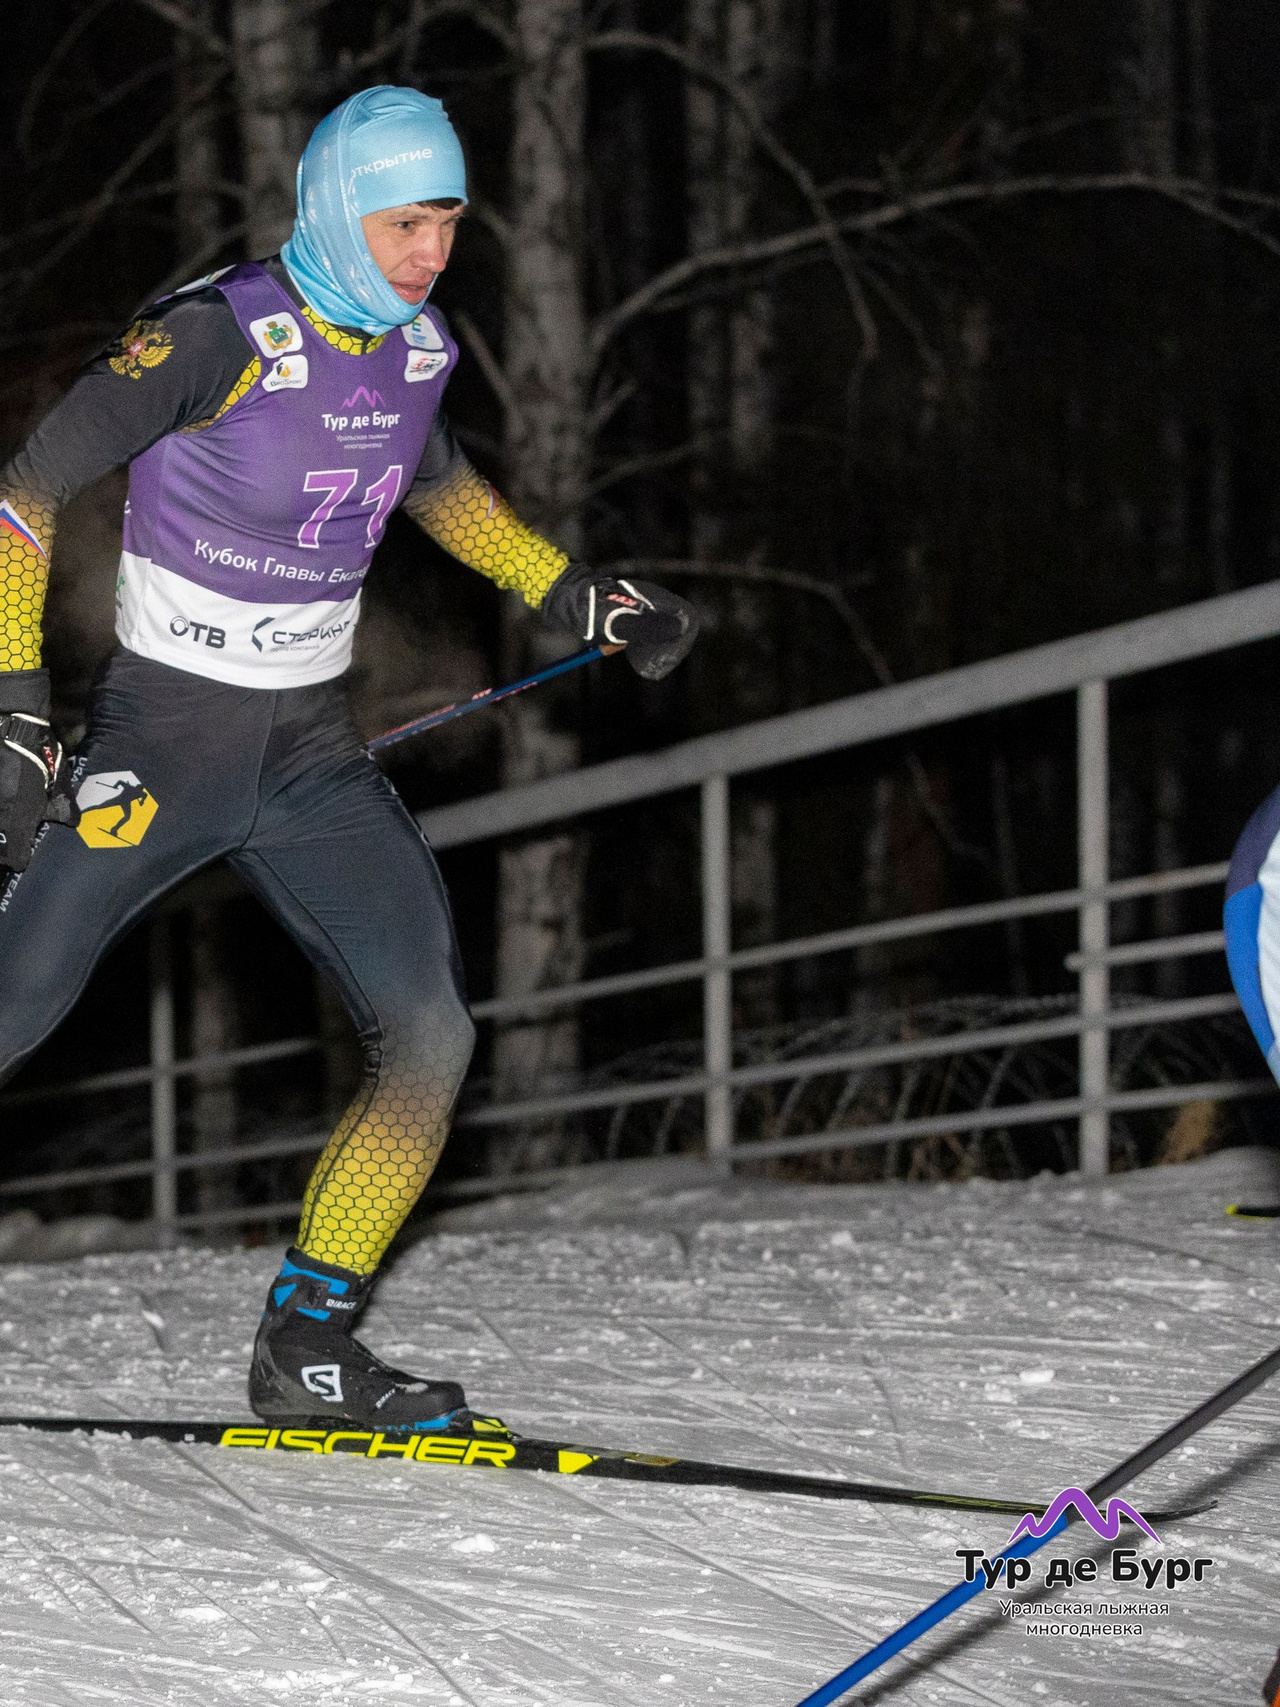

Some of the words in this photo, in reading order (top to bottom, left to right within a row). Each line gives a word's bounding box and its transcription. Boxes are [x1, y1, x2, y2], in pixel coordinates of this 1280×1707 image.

[322, 413, 348, 431] Тур
[351, 415, 369, 429] де
[372, 411, 401, 428] Бург
[297, 464, 403, 549] 71
[194, 538, 257, 572] Кубок
[263, 557, 325, 582] Главы
[70, 756, 88, 788] URA
[0, 872, 23, 912] TEAM
[220, 1427, 516, 1467] FISCHER
